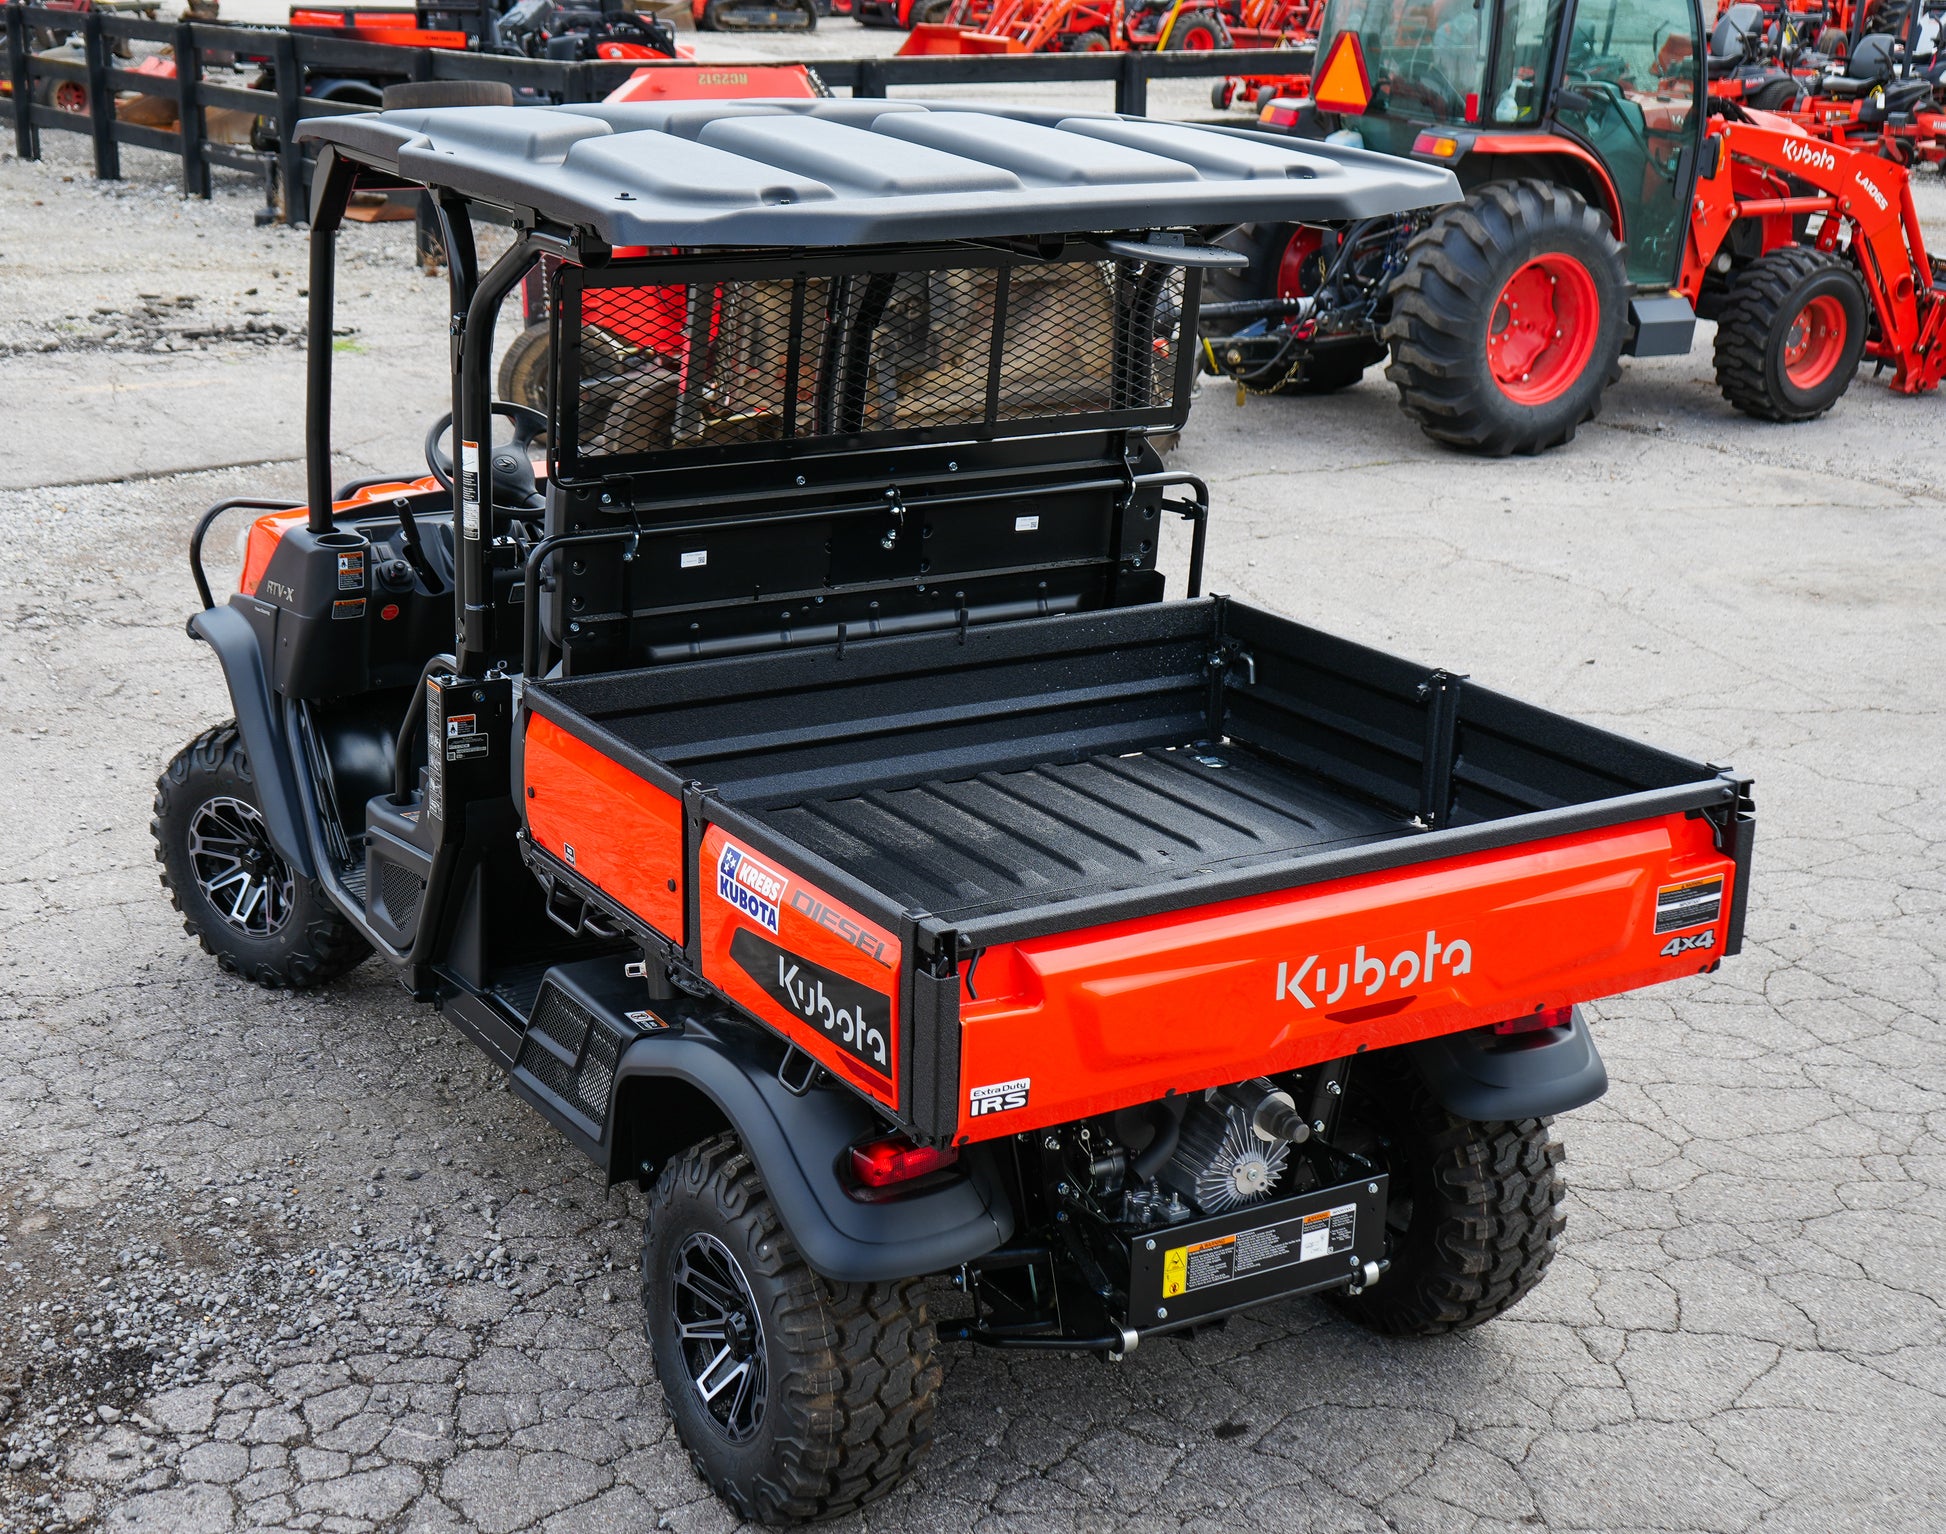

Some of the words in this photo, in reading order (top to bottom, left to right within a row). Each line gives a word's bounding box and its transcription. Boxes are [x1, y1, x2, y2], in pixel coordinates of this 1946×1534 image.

[1782, 138, 1836, 171] Kubota
[738, 862, 781, 901] KREBS
[719, 876, 778, 932] KUBOTA
[790, 889, 892, 970] DIESEL
[1660, 929, 1716, 957] 4x4
[1275, 930, 1473, 1010] Kubota
[777, 954, 887, 1066] Kubota
[971, 1091, 1027, 1117] IRS
[973, 1088, 1001, 1097] Extra
[1002, 1082, 1027, 1092] Duty
